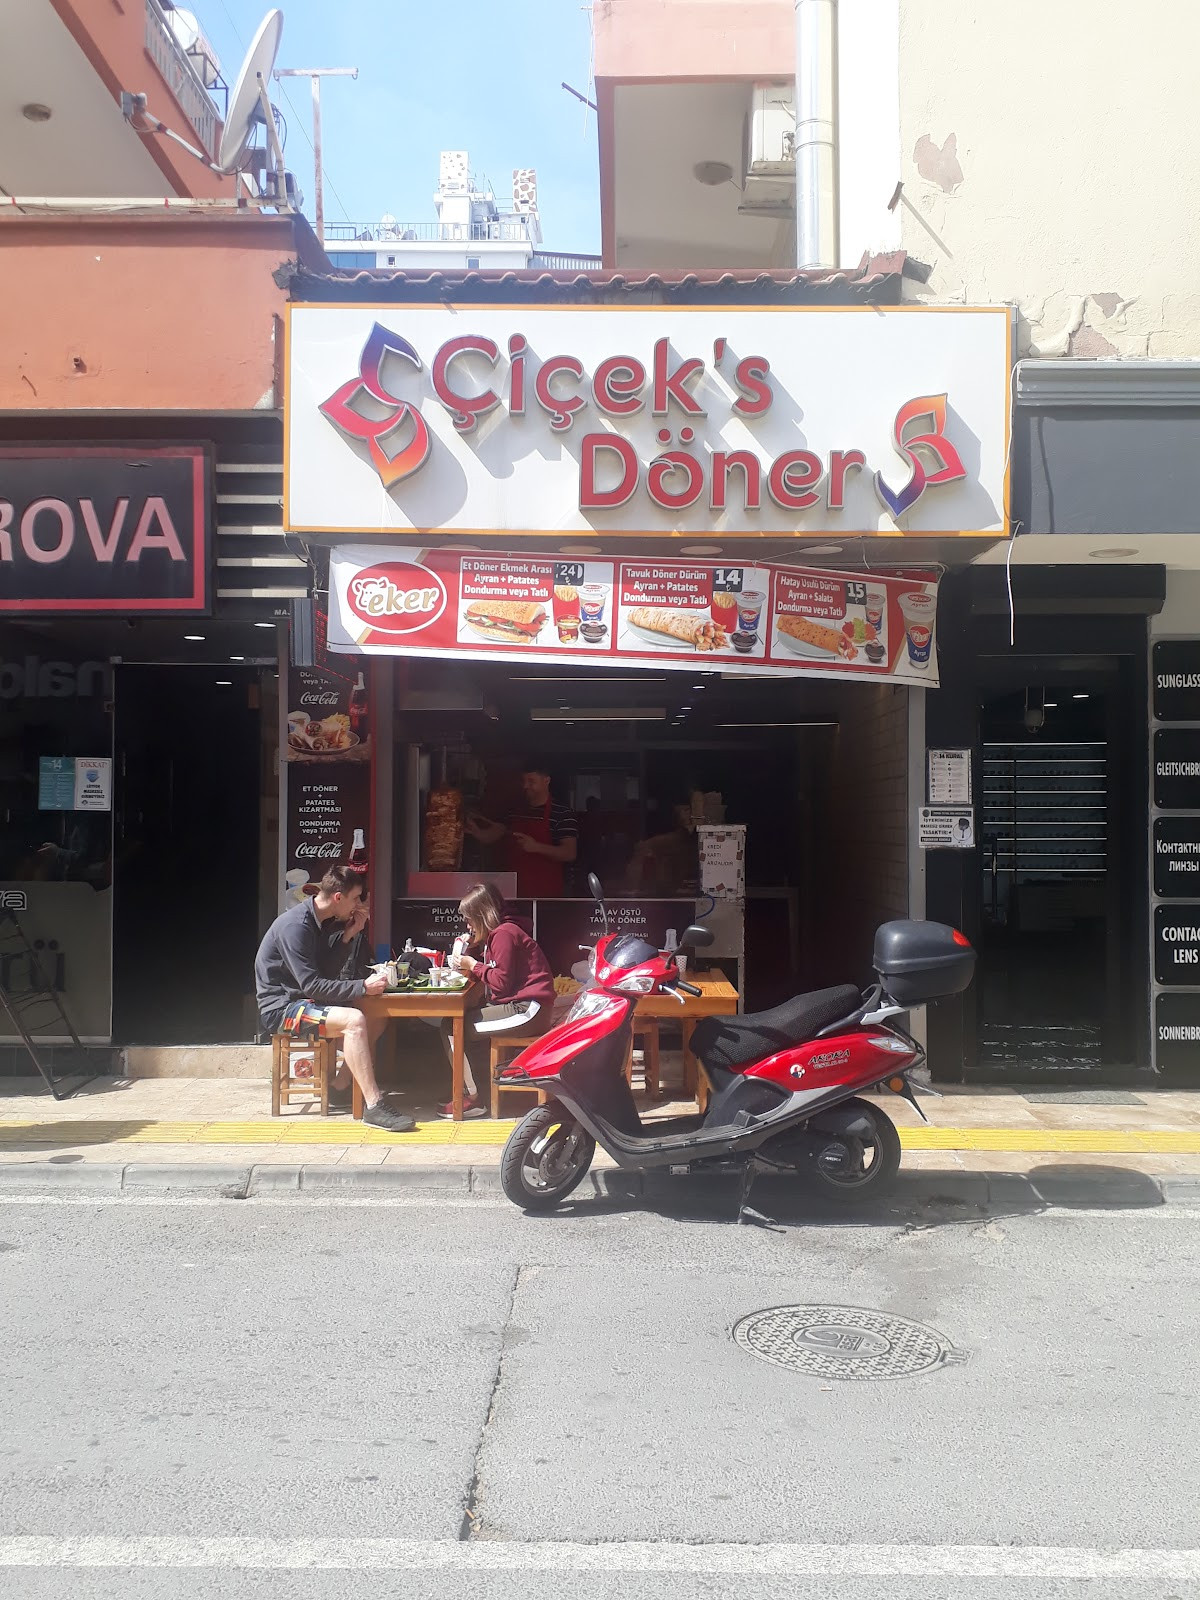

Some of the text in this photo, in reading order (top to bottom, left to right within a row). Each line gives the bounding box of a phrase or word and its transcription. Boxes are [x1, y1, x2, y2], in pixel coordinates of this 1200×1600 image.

[431, 333, 773, 433] Çiçek's
[579, 427, 866, 511] Döner
[463, 561, 552, 574] Et Döner Ekmek Arası
[560, 564, 576, 577] 24
[626, 568, 707, 580] Tavuk Döner Dürüm
[474, 574, 499, 585] Ayran
[507, 575, 539, 585] Patates
[715, 569, 741, 585] 14
[780, 575, 800, 588] Hatay
[820, 581, 840, 592] Dürüm
[464, 585, 508, 596] Dondurma
[509, 588, 529, 597] veya
[634, 581, 658, 592] Ayran
[667, 583, 699, 592] Patates
[847, 583, 865, 598] 15
[367, 586, 437, 614] eker
[624, 592, 667, 603] Dondurma
[668, 595, 688, 604] veya
[788, 589, 808, 601] Ayran
[814, 593, 834, 603] Salata
[777, 602, 813, 613] Dondurma
[813, 606, 829, 616] veya
[295, 841, 344, 858] Coca-Cola
[1169, 861, 1199, 872] линзы
[432, 907, 456, 915] PİLAV
[620, 908, 641, 916] ÜSTÜ
[447, 915, 465, 923] DÖN
[618, 916, 647, 924] DÖNER
[1174, 949, 1199, 964] LENS
